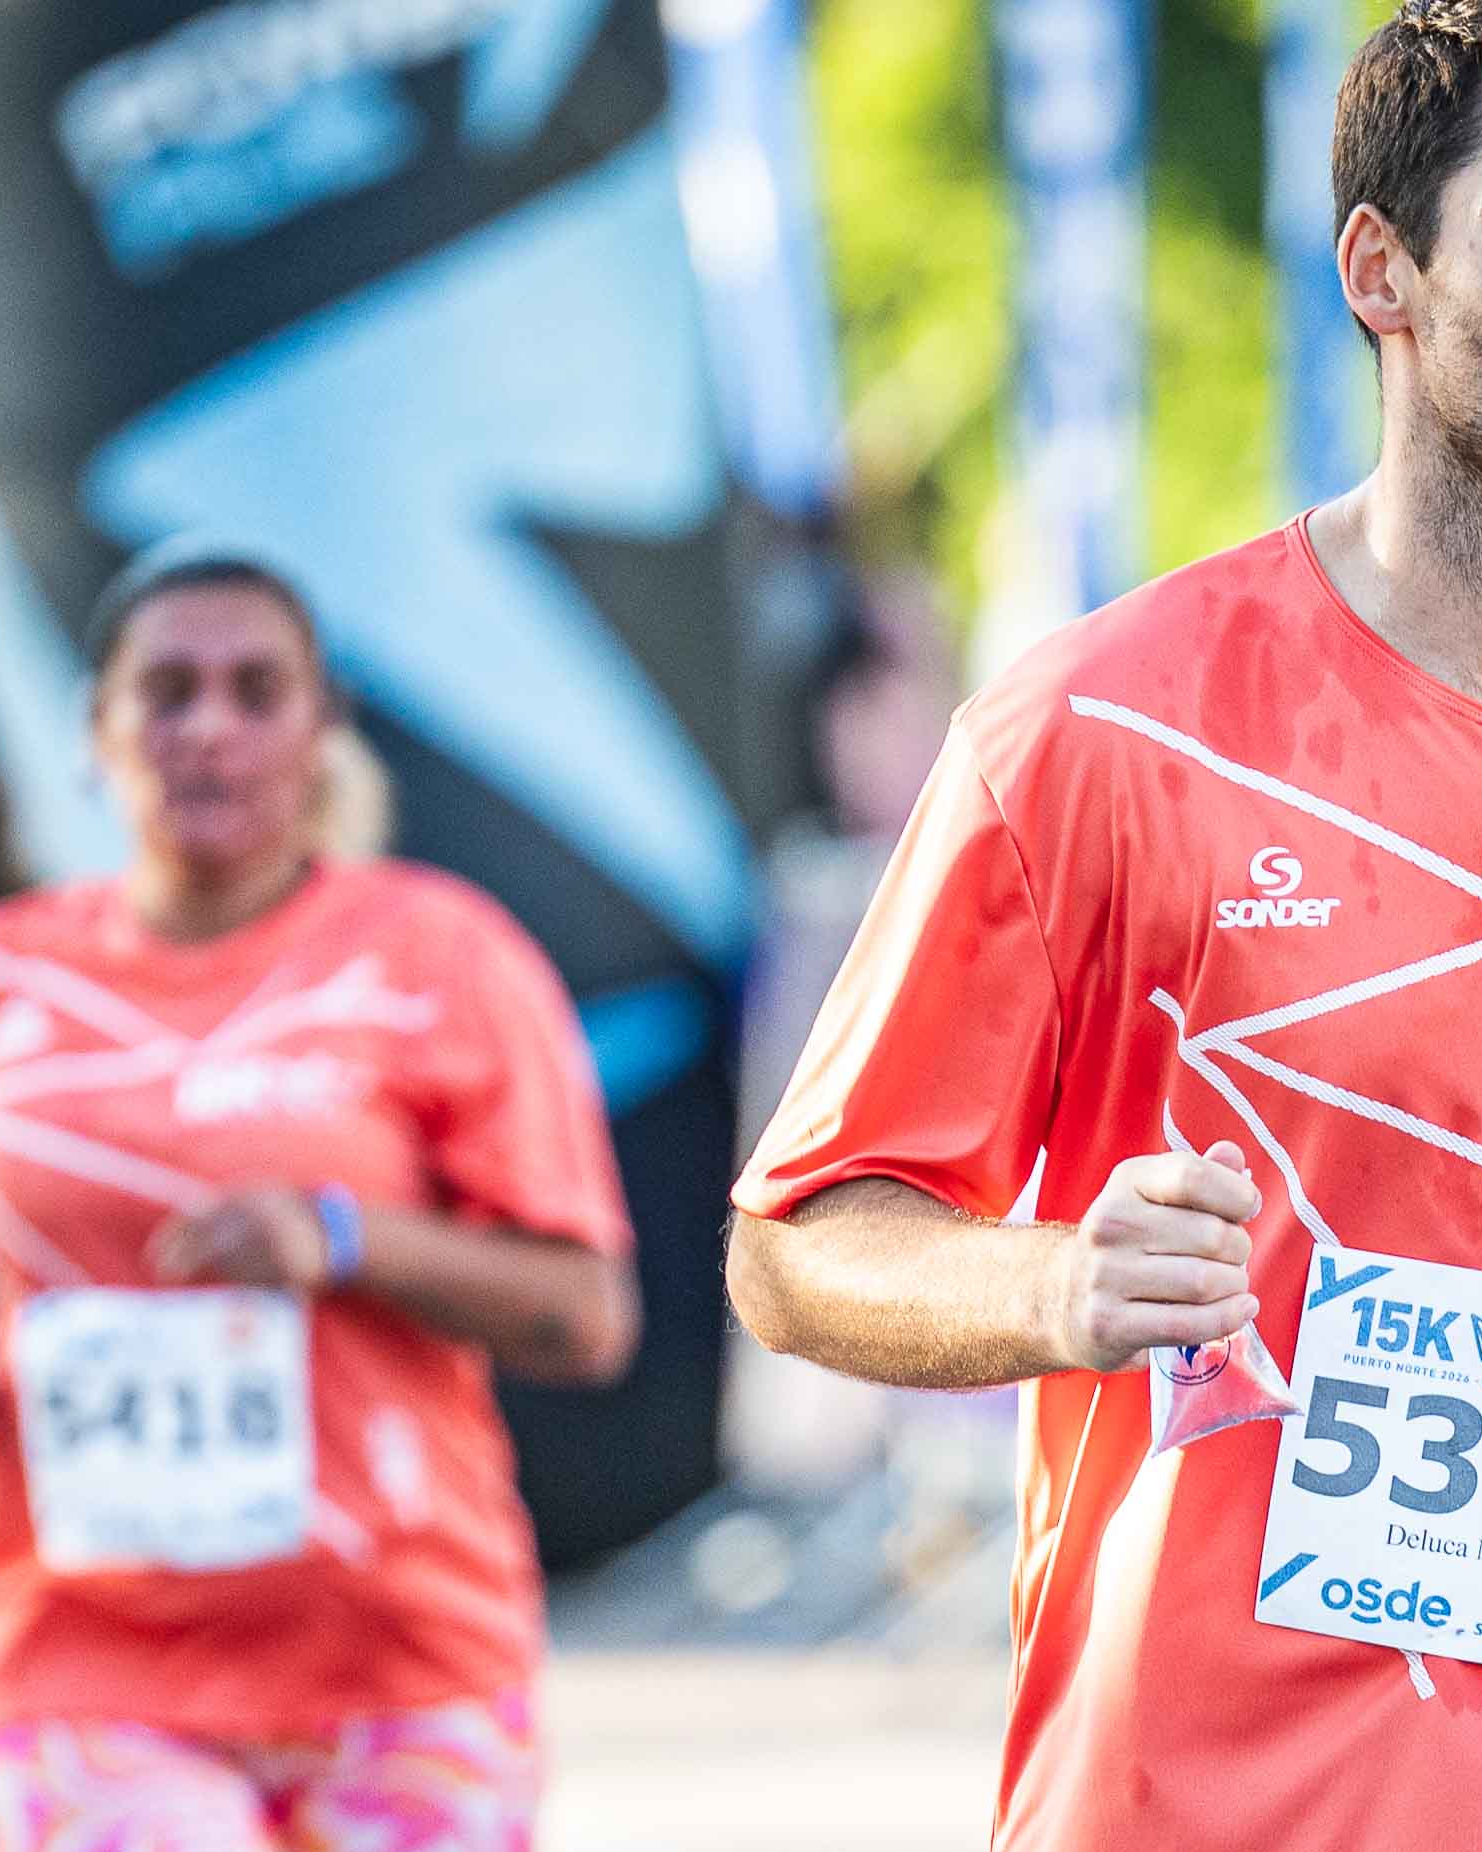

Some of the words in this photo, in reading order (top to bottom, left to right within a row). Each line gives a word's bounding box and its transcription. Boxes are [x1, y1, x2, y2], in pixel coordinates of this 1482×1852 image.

[1352, 1297, 1461, 1361] 15K
[1343, 1353, 1391, 1370] PUERTO
[1395, 1364, 1434, 1378] NORTE
[1387, 1523, 1467, 1559] Deluca
[1320, 1577, 1451, 1627] osde
